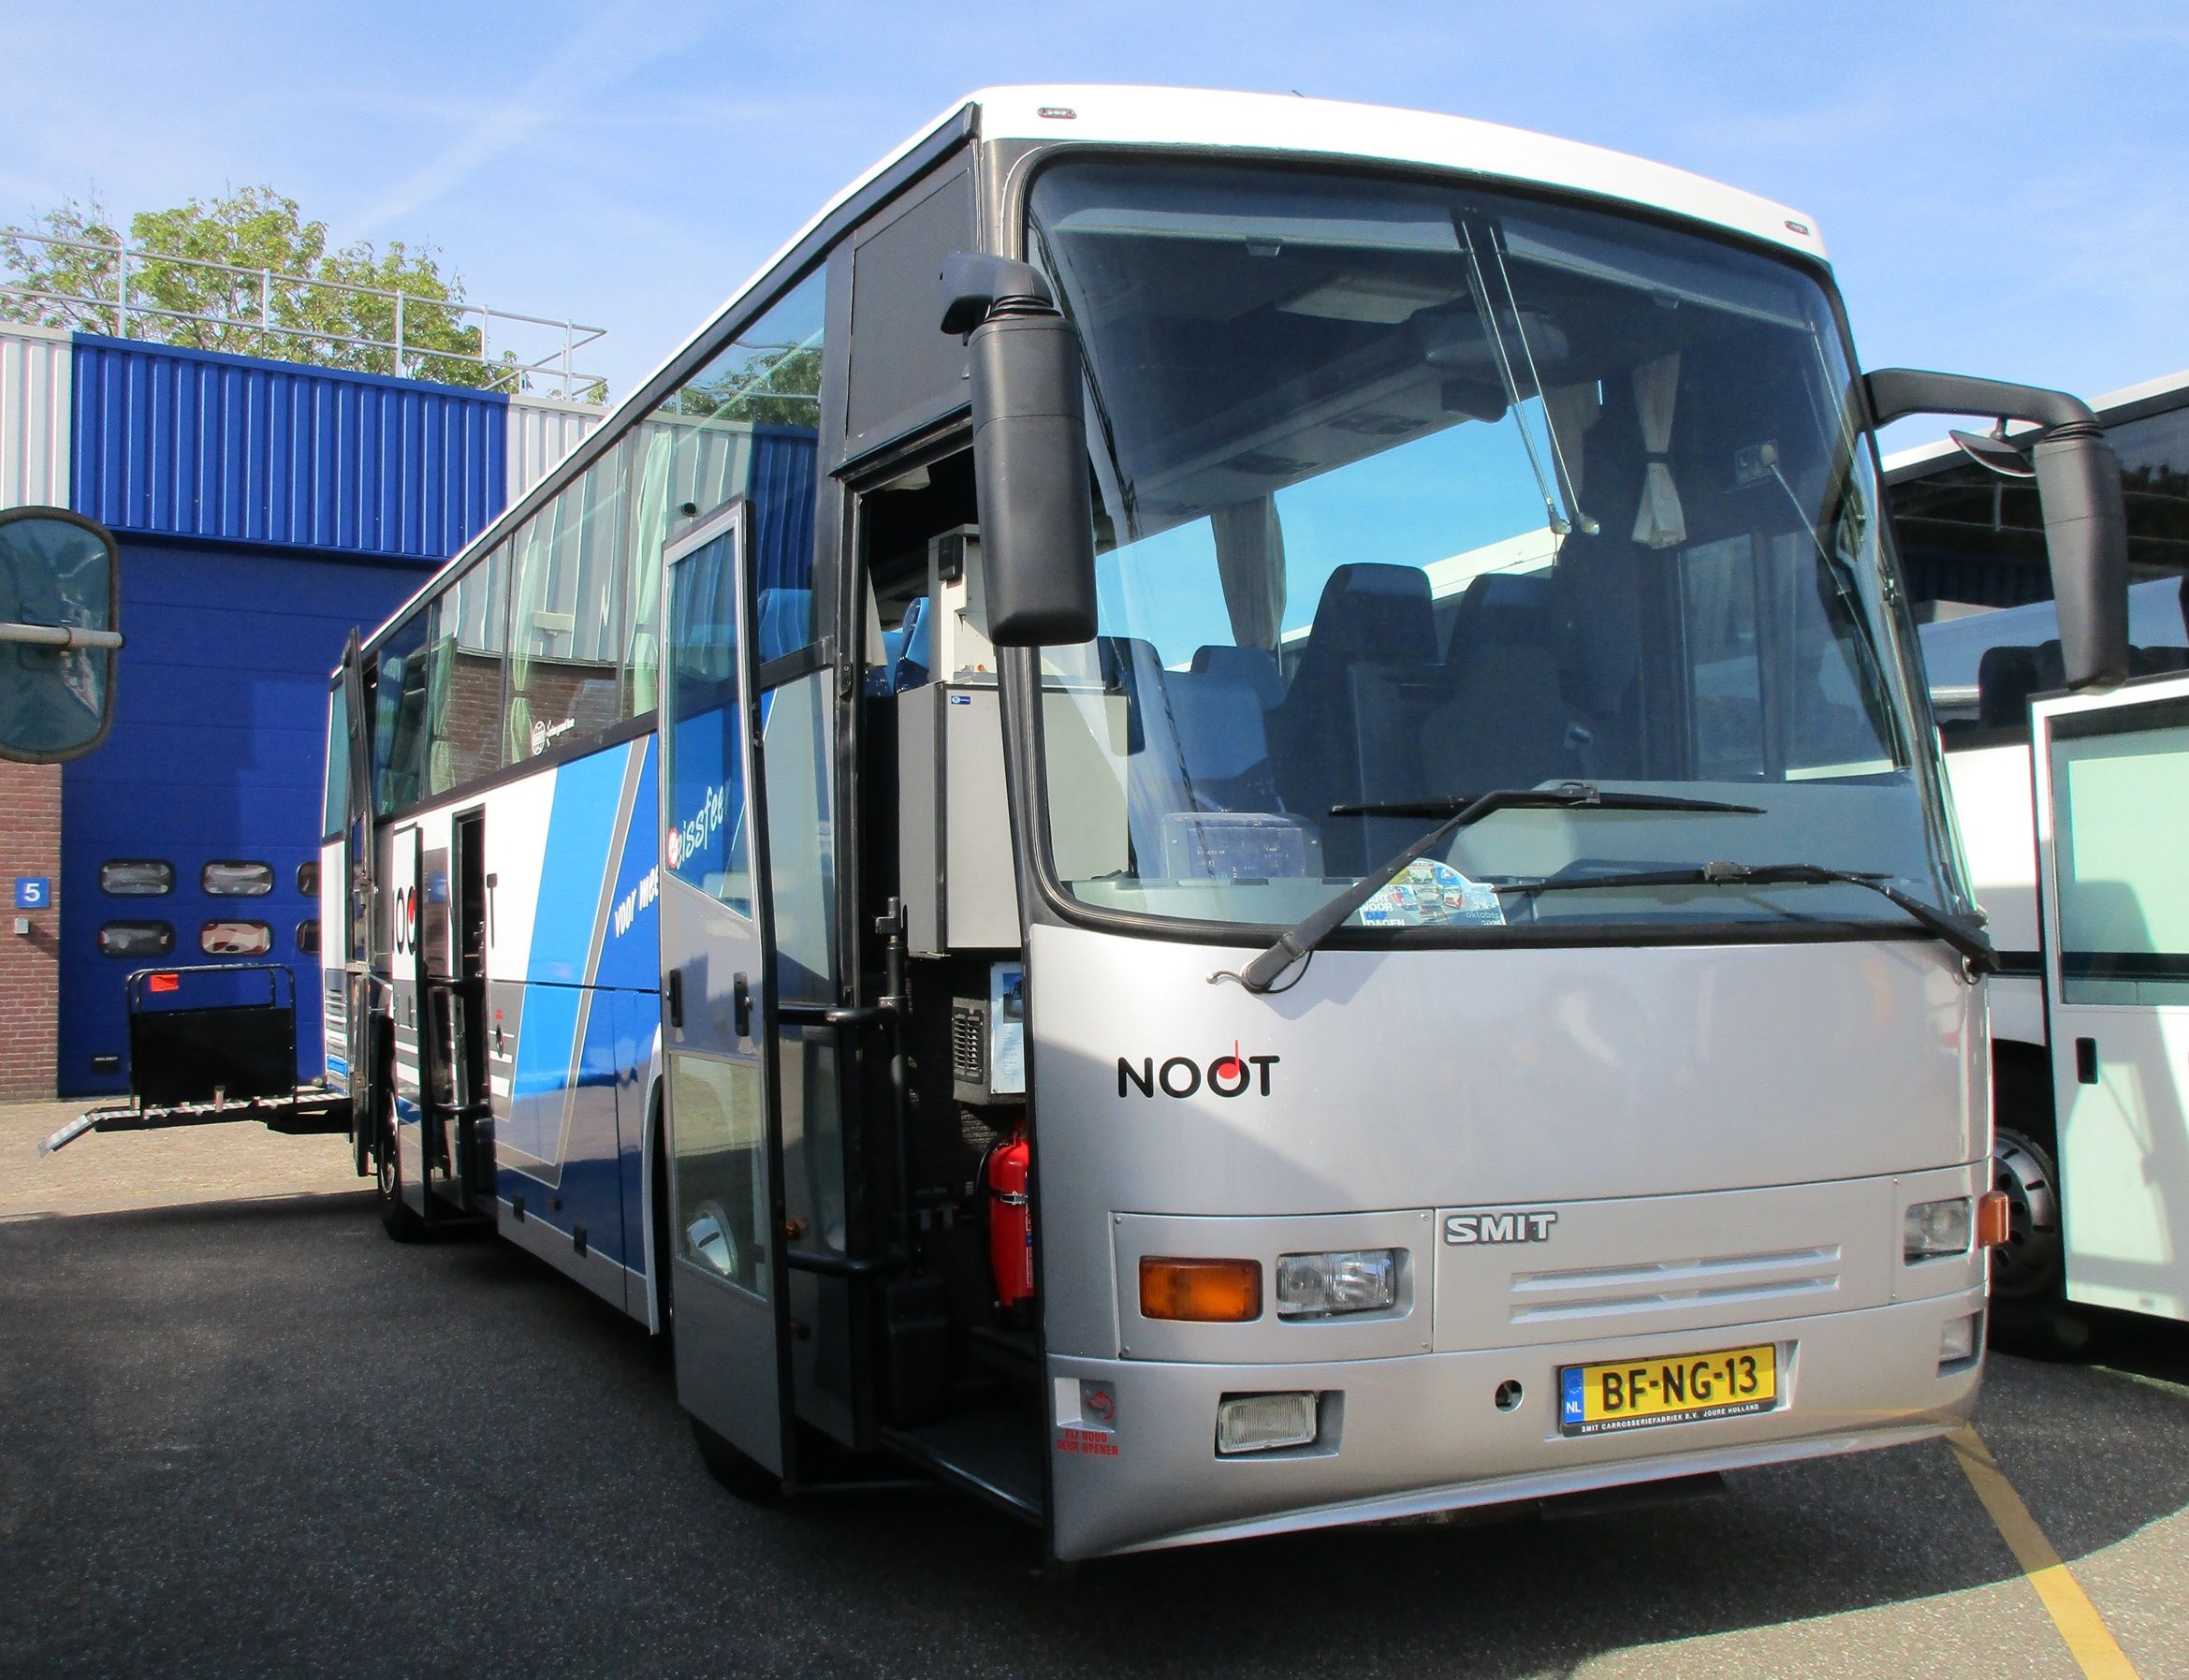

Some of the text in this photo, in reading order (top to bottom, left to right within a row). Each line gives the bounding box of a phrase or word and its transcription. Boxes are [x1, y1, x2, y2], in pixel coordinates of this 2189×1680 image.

[25, 883, 41, 902] 5
[1367, 894, 1389, 904] ART
[615, 888, 637, 939] voor
[1466, 911, 1499, 919] oktober
[1117, 1054, 1280, 1099] NOOT
[1445, 1212, 1557, 1245] SMIT
[1601, 1354, 1758, 1411] BF-NG-13
[1566, 1402, 1582, 1413] NL
[1581, 1424, 1599, 1433] SMIT
[1601, 1414, 1684, 1430] CARROSSERIEFABRIEK
[1702, 1408, 1726, 1418] JOURE
[1727, 1404, 1759, 1414] HOLLAND
[1082, 1442, 1119, 1456] OPENEN
